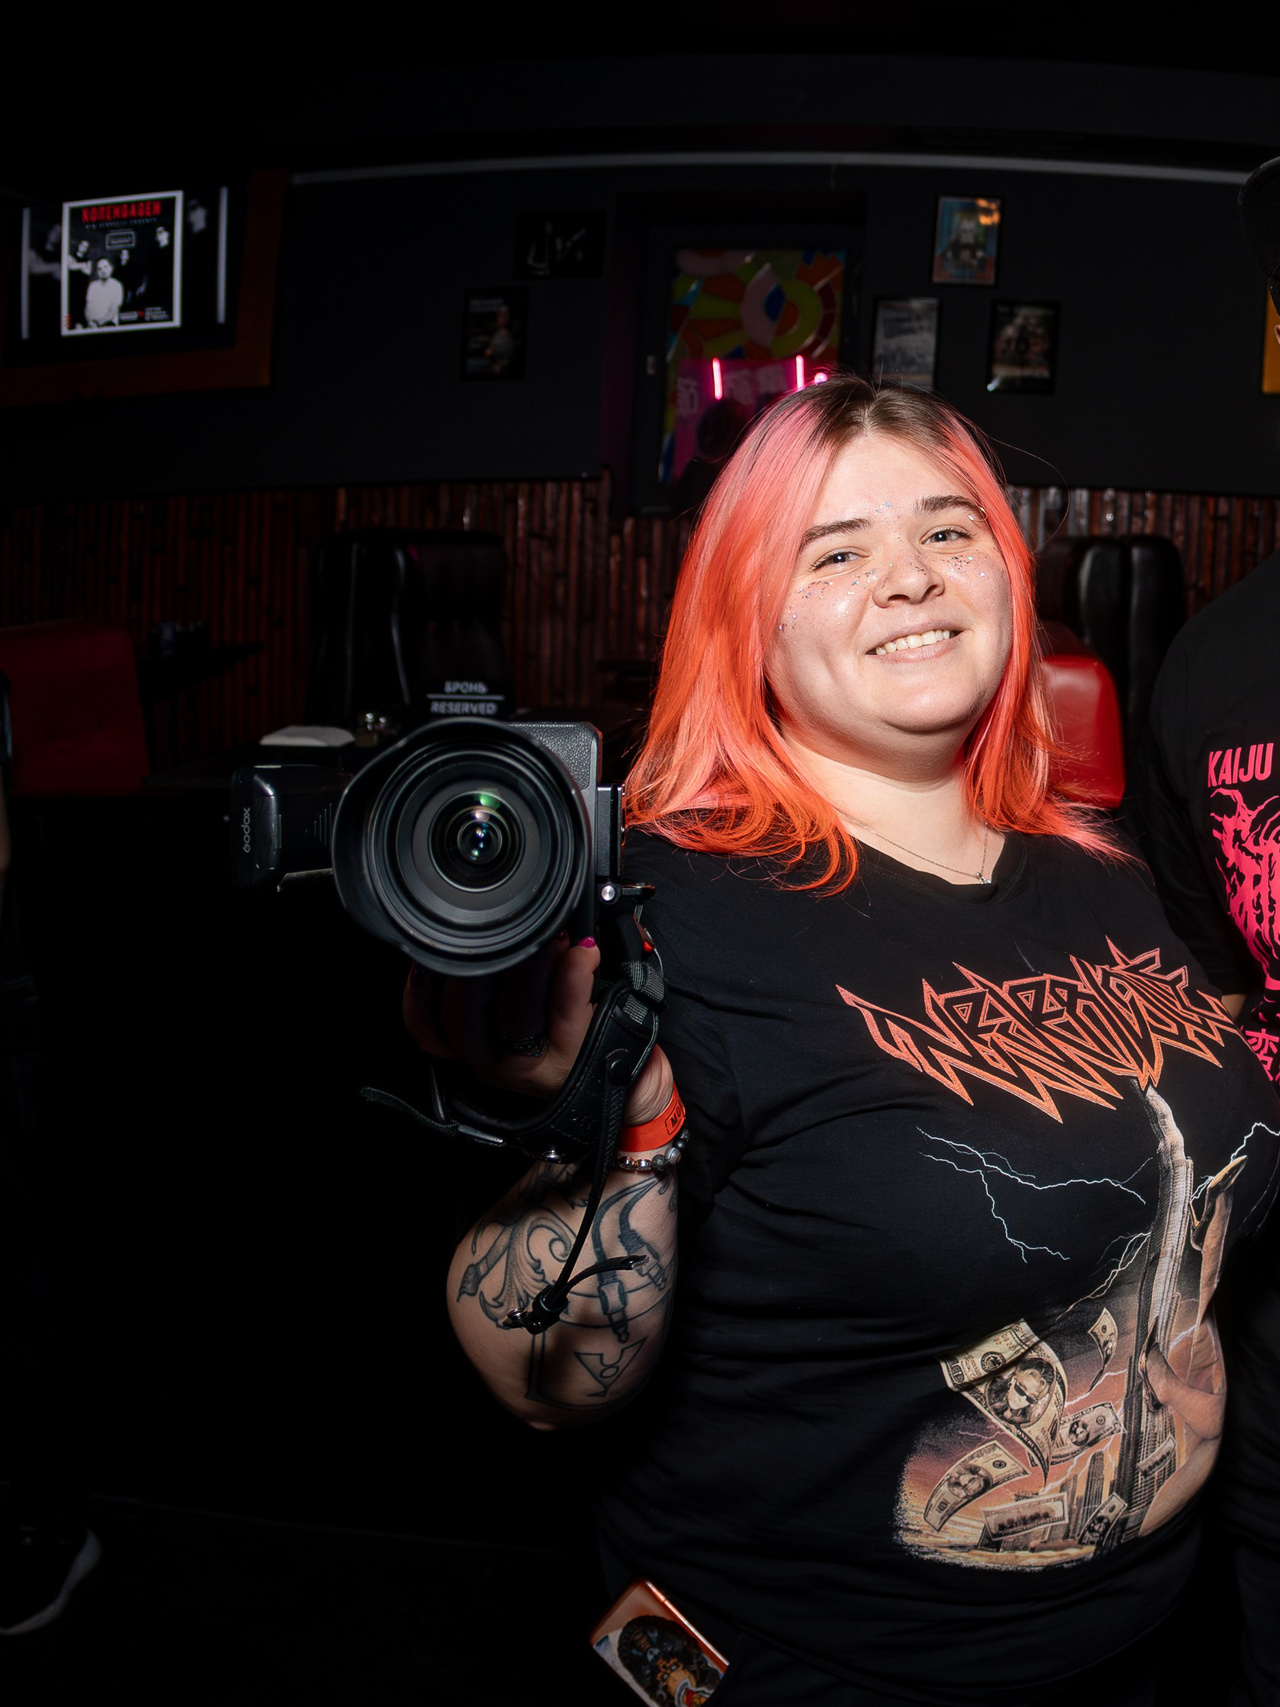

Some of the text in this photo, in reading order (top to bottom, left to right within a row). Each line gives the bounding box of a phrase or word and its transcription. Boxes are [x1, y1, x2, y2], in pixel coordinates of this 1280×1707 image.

[443, 680, 489, 694] БРОНЬ
[430, 700, 499, 716] RESERVED
[1207, 741, 1275, 789] KAIJU
